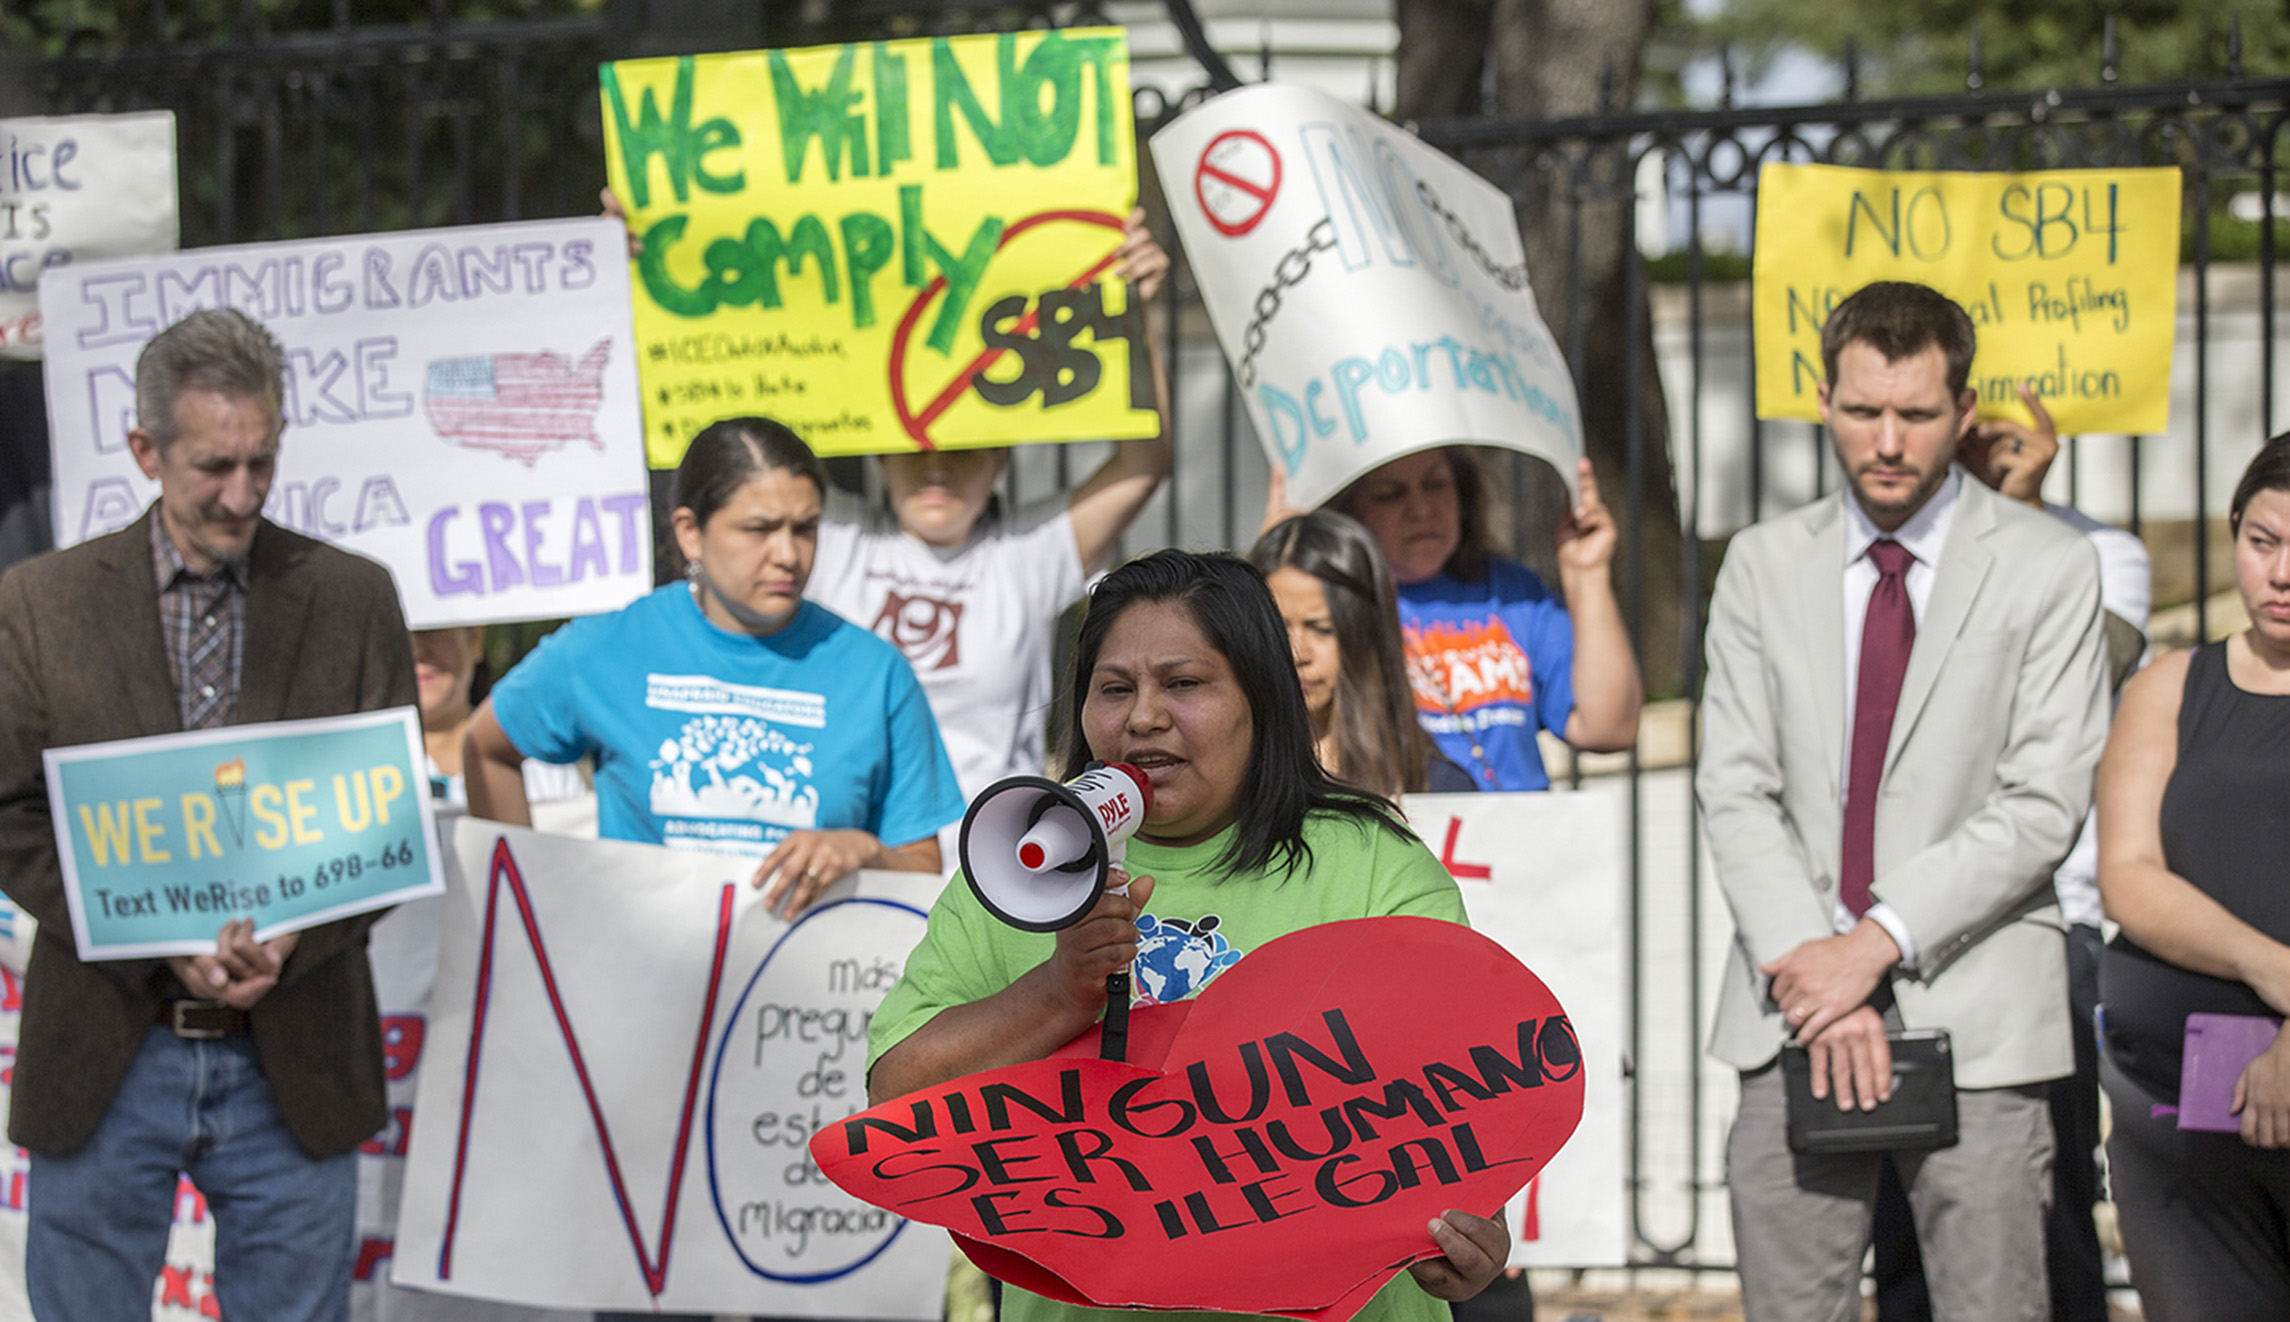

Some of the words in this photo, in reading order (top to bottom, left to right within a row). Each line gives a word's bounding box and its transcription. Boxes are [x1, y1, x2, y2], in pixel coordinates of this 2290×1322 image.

[0, 134, 82, 193] ice
[600, 54, 746, 210] We
[768, 41, 912, 183] Will
[931, 29, 1128, 171] NOT
[1299, 121, 1461, 288] NO
[1845, 184, 1952, 264] NO
[1992, 183, 2127, 266] SB4
[77, 239, 598, 350] IMMIGRANTS
[637, 185, 1004, 357] Comply
[2027, 275, 2130, 335] Profiling
[971, 281, 1155, 410] SB4
[428, 494, 650, 597] GREAT
[78, 797, 171, 867] WE
[333, 764, 404, 833] UP
[1097, 792, 1131, 829] PYLE
[96, 887, 159, 919] Text
[164, 880, 271, 914] WeRise
[278, 873, 306, 901] to
[315, 838, 415, 890] 698-66
[797, 1055, 847, 1098] de
[845, 1008, 1377, 1156] NINGUN
[873, 1129, 1154, 1206] SER
[1190, 1014, 1582, 1184] HUMANO
[970, 1188, 1125, 1239] ES
[1154, 1122, 1534, 1240] ILEGAL
